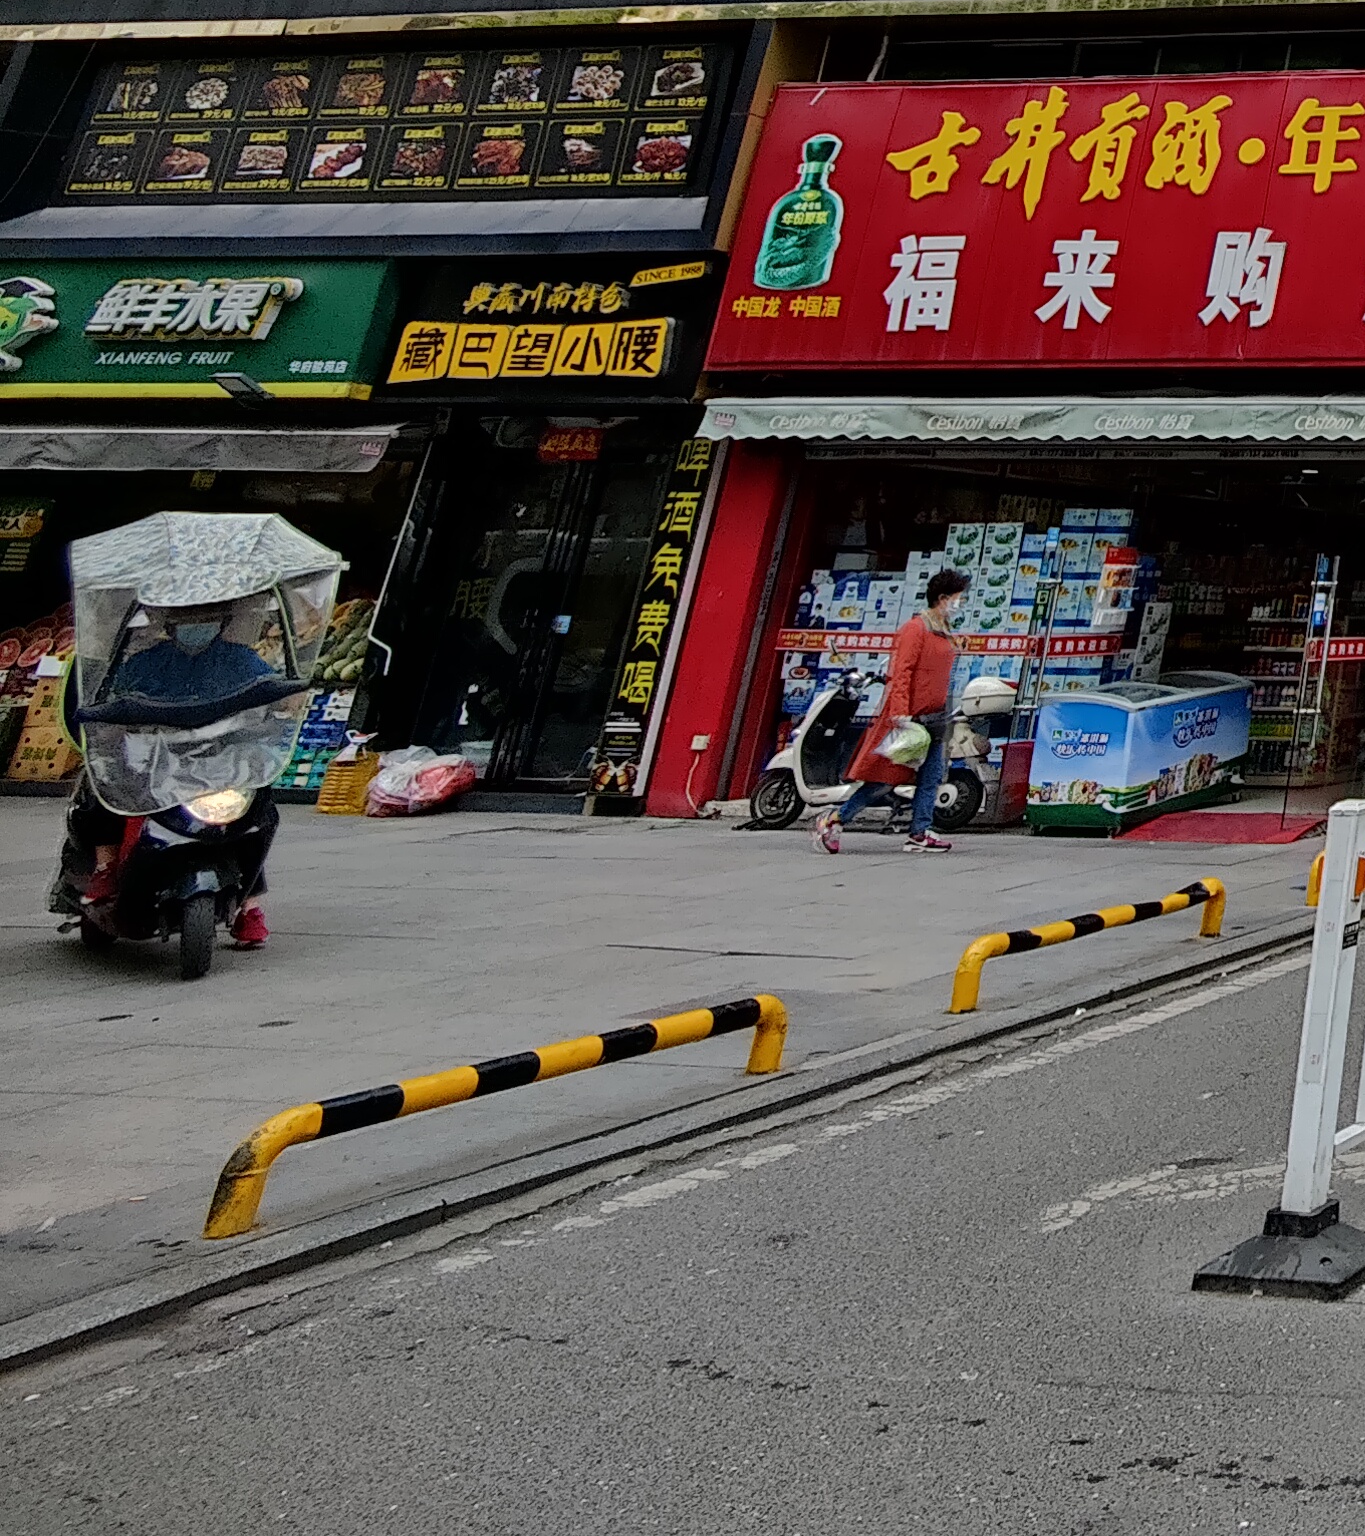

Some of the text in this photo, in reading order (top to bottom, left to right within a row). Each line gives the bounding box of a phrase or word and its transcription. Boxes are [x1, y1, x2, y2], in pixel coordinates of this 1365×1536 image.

[635, 269, 677, 285] SINCE
[84, 282, 271, 334] 鲜丰水果
[732, 295, 842, 318] 中国龙 中国酒
[95, 351, 234, 365] XIANFENG FRUIT
[399, 325, 662, 378] 藏巴望小腰
[926, 413, 985, 432] Cestbon
[1094, 413, 1156, 432] Cestbon
[1295, 413, 1355, 432] Cestbon
[618, 438, 713, 715] 啤酒免费喝
